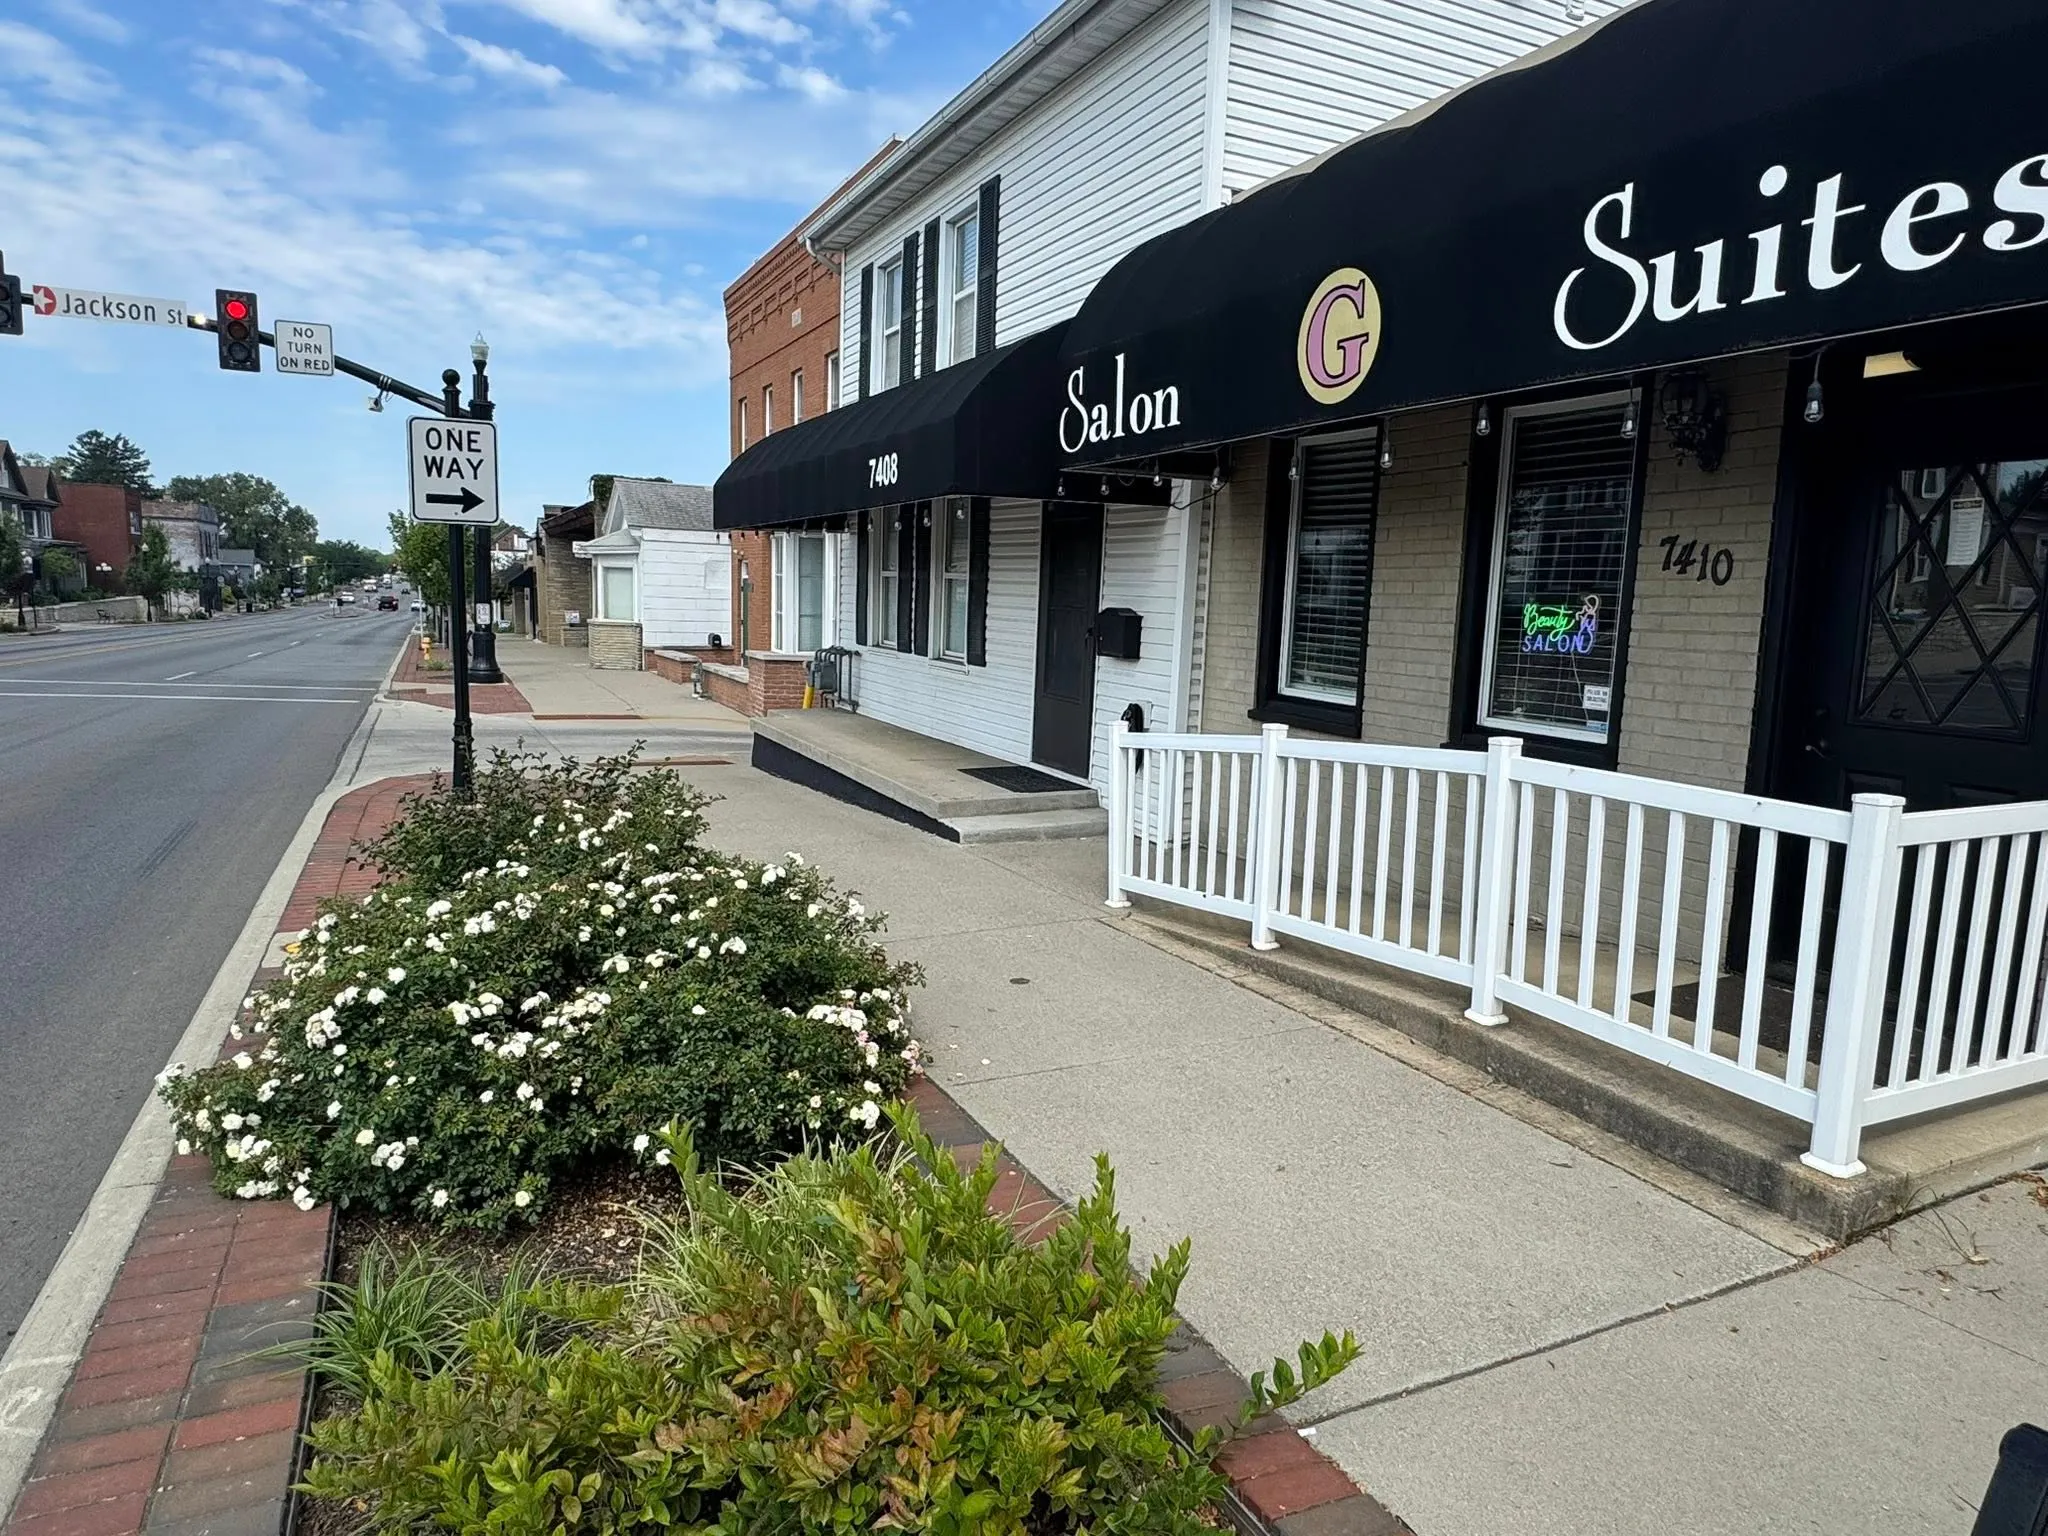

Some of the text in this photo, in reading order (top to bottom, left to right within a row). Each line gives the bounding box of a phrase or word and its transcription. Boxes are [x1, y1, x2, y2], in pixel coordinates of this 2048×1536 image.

[62, 293, 183, 325] Jackson St
[1059, 155, 2048, 453] Salon G Suites
[293, 327, 314, 339] NO
[287, 341, 322, 355] TURN
[280, 356, 330, 371] ON RED
[425, 427, 482, 453] ONE
[423, 455, 484, 480] WAY
[868, 452, 899, 488] 7408
[1660, 534, 1734, 586] 7410
[1523, 603, 1575, 641] Beauty
[1522, 634, 1584, 652] SALON
